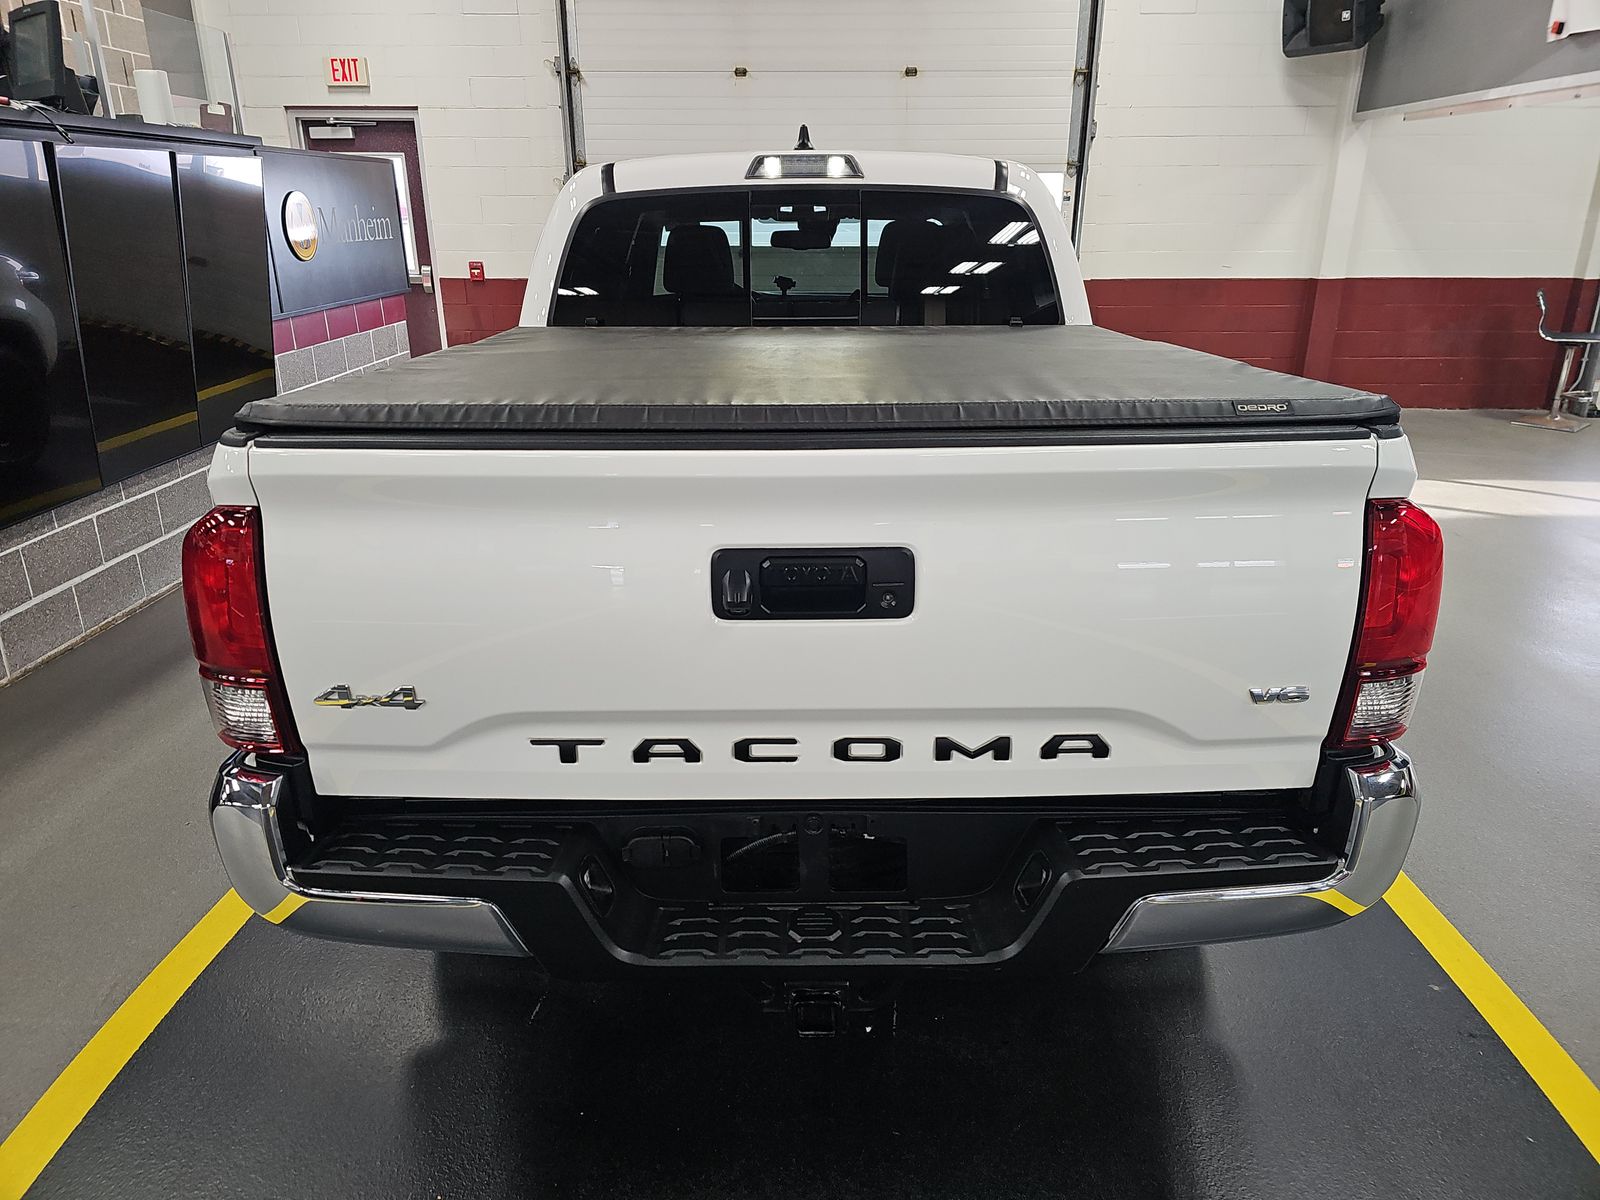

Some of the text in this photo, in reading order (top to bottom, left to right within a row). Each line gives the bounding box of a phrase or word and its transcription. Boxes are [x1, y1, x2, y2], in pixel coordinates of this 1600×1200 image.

[330, 58, 359, 82] EXIT
[1248, 685, 1310, 704] V6
[529, 734, 1111, 764] TACOMA
